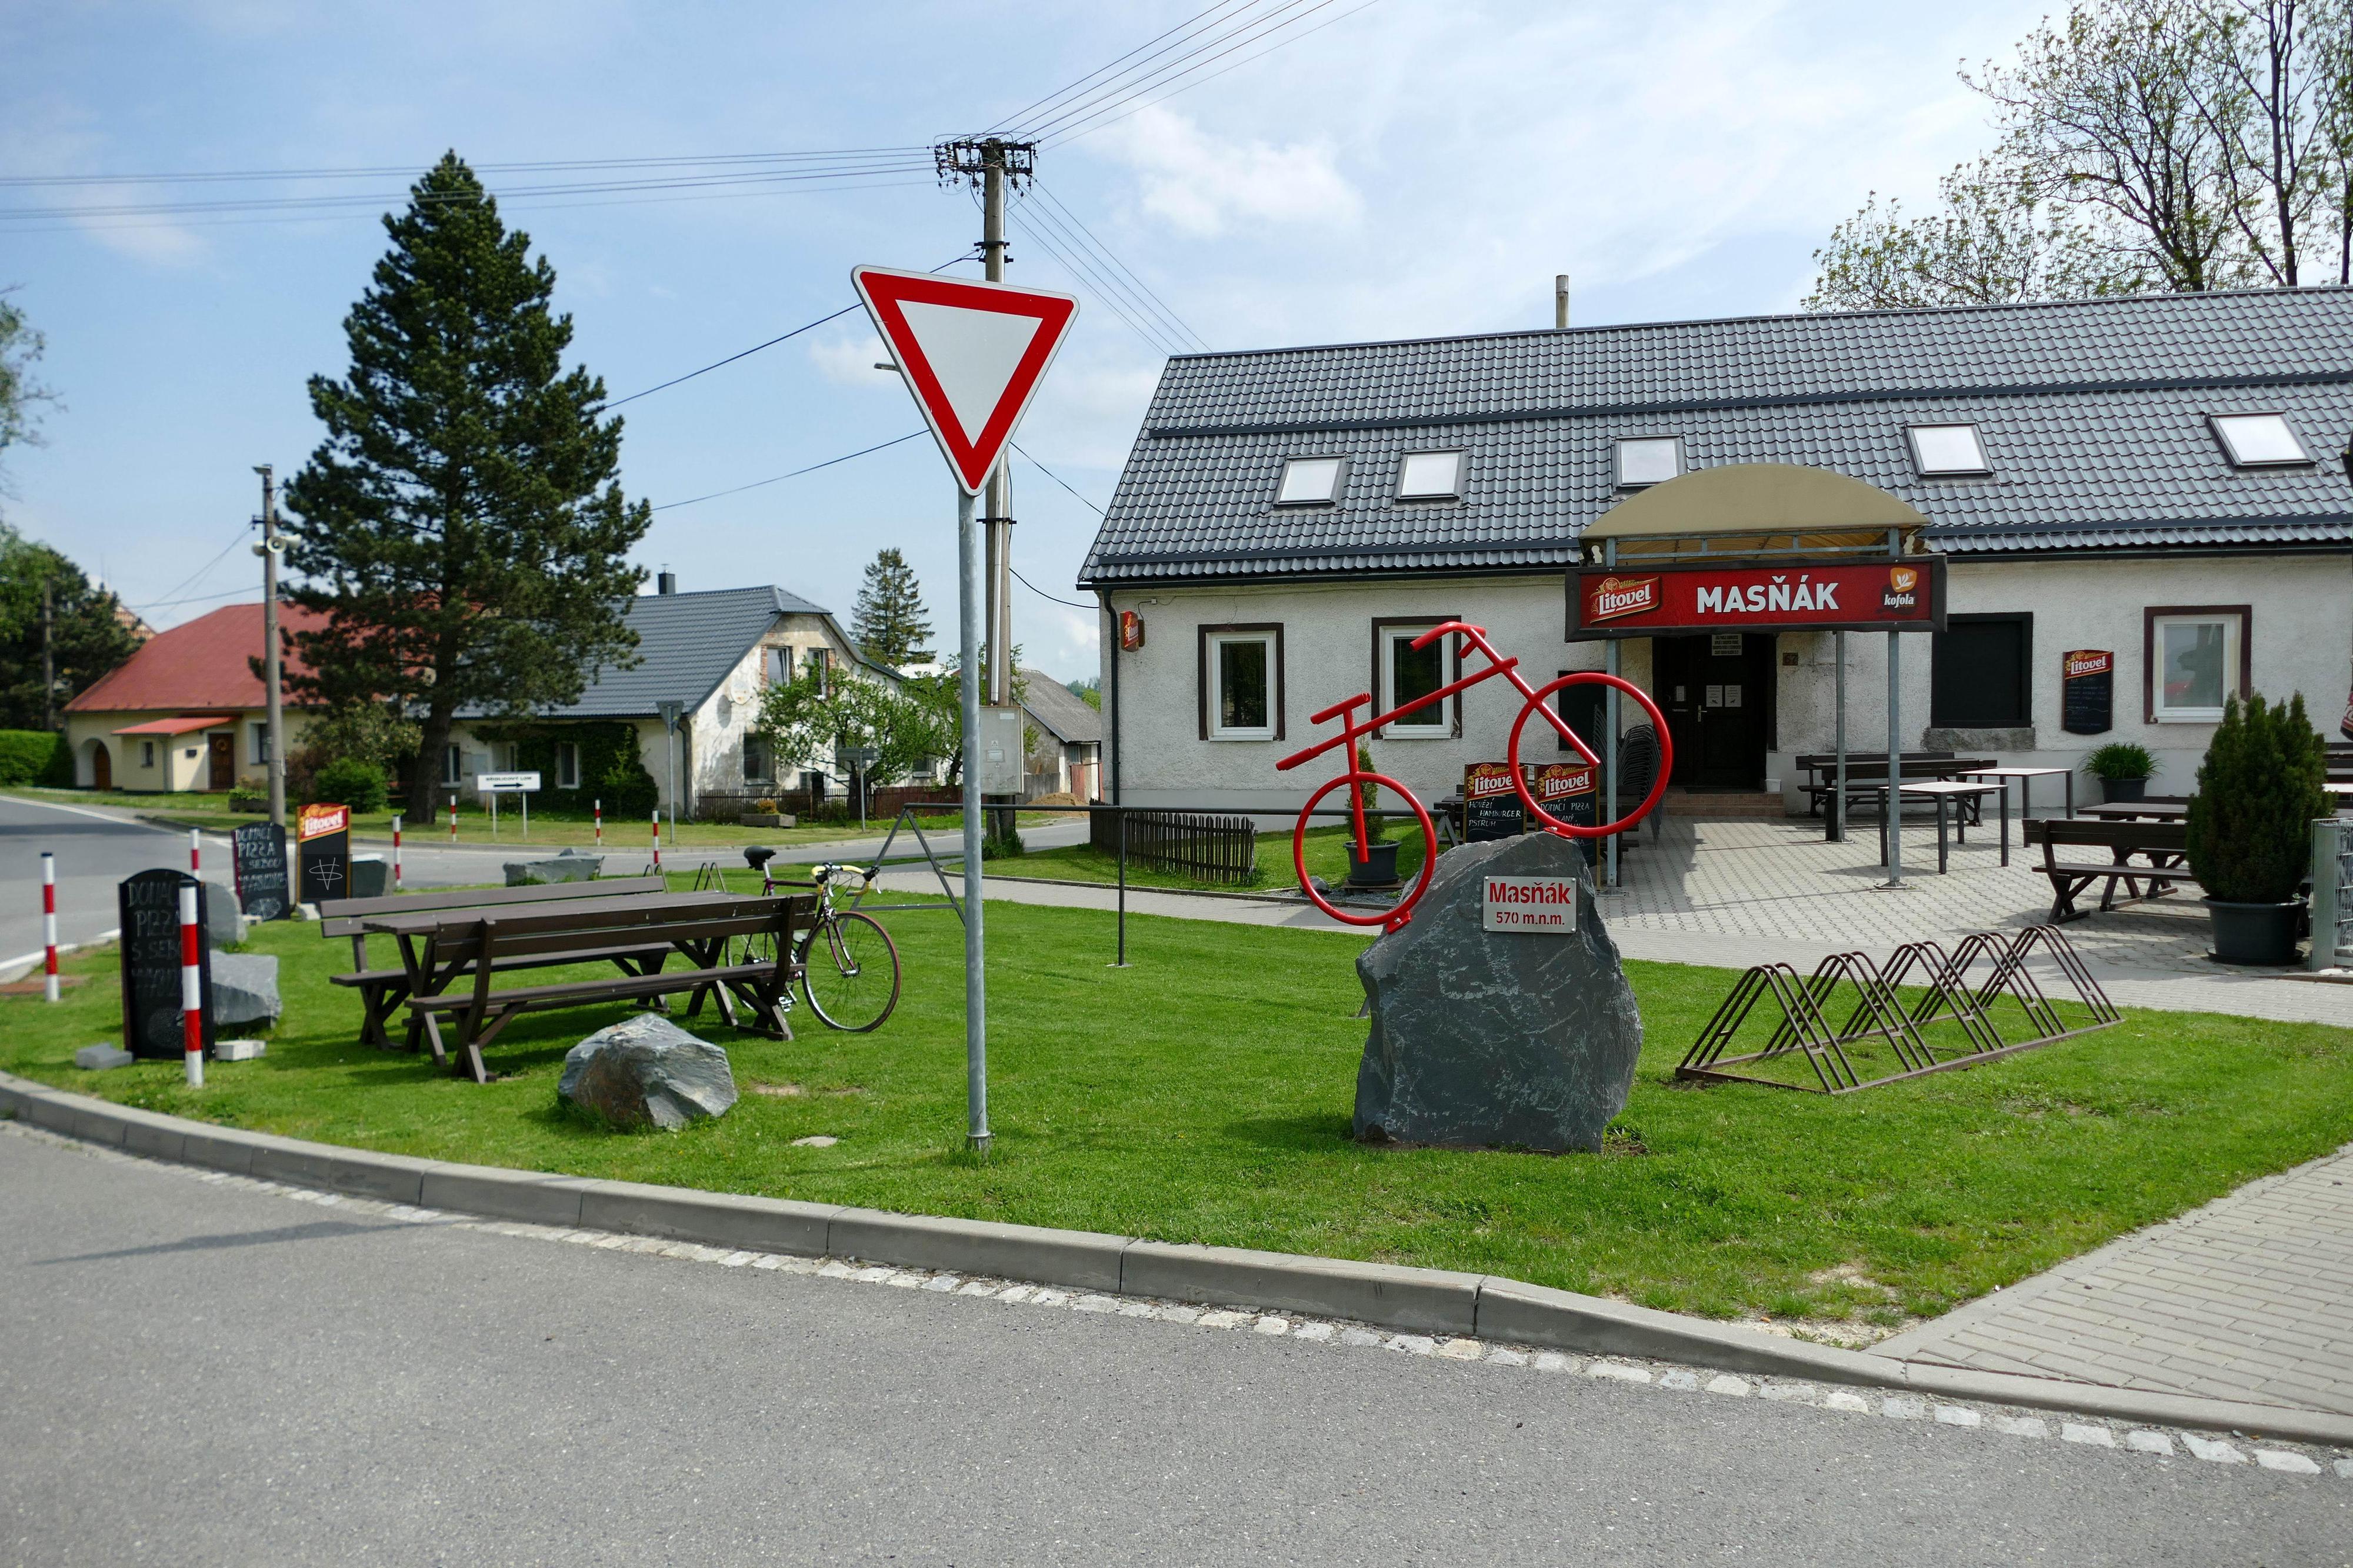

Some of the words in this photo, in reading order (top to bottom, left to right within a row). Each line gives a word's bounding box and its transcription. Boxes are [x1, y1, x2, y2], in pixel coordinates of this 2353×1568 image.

[1599, 584, 1651, 615] Litovel
[1697, 575, 1839, 613] MASŇÁK
[1884, 593, 1914, 608] kofola
[2071, 656, 2106, 675] Litovel
[1474, 775, 1514, 795] Litove
[1545, 771, 1590, 797] Litovel
[304, 810, 344, 836] Litovel
[1489, 882, 1571, 904] Masňák
[1496, 912, 1519, 924] 570
[1523, 913, 1565, 925] m.n.m.
